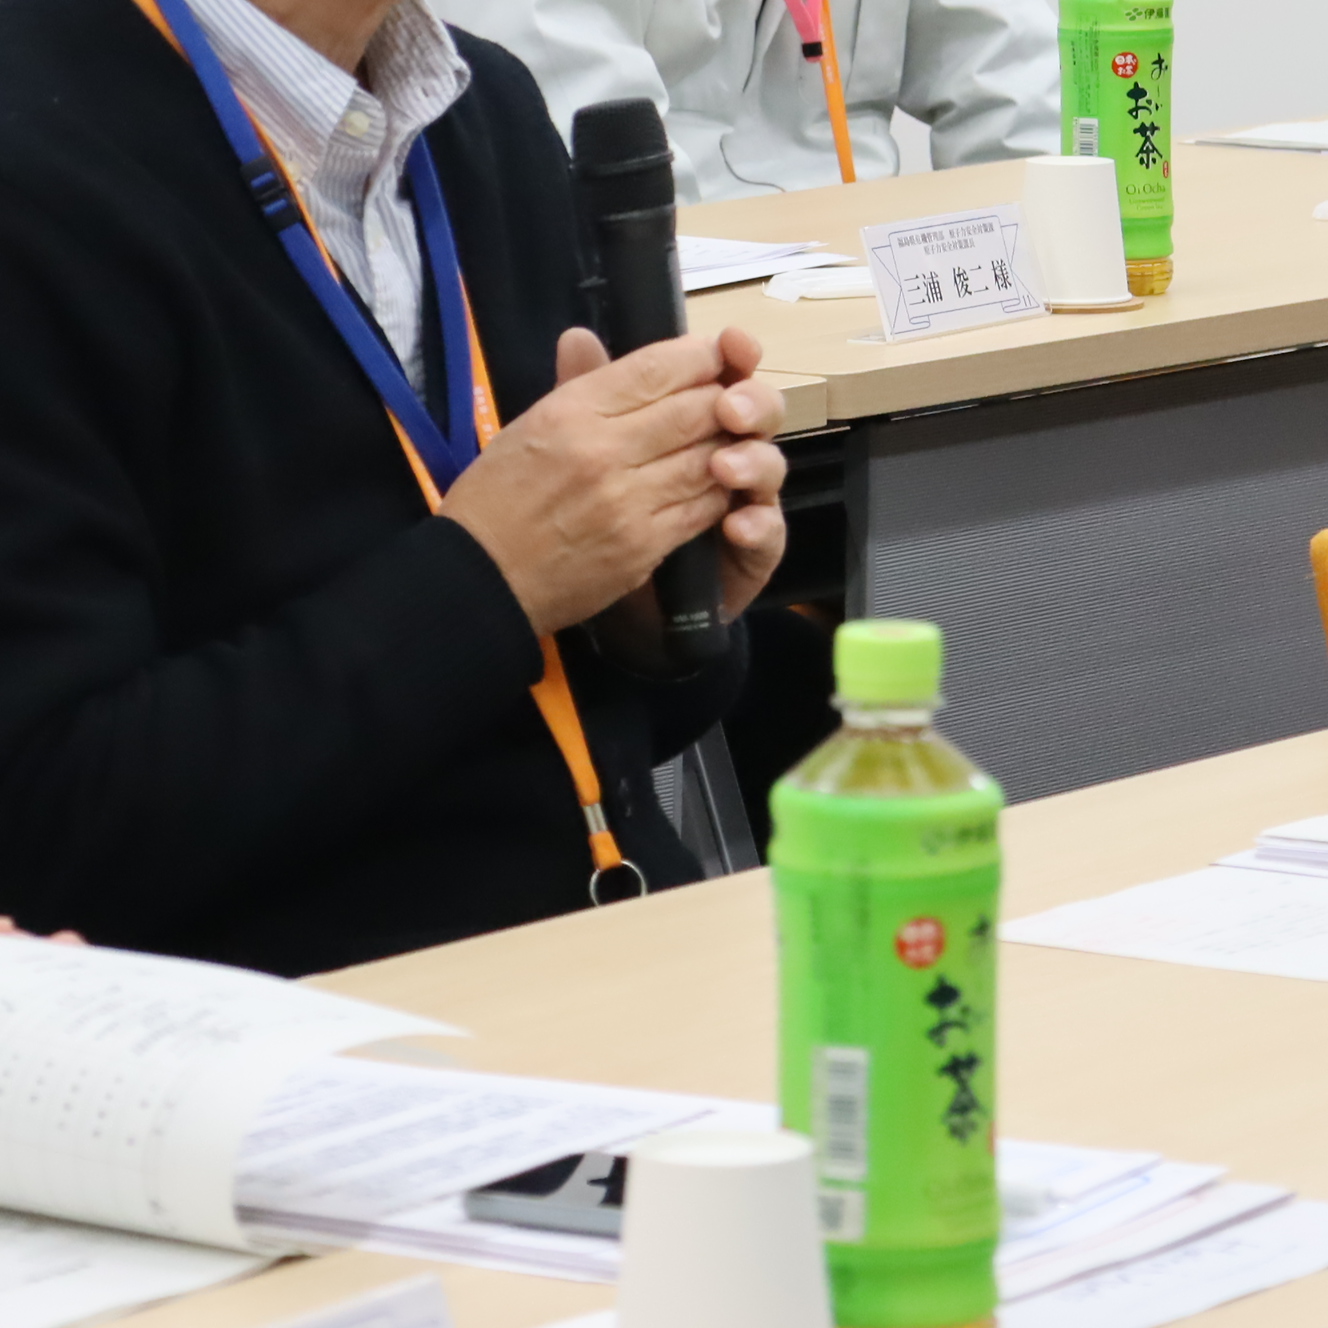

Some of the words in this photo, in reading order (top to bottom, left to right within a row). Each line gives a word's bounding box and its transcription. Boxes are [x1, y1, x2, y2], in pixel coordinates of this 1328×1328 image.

[1126, 81, 1163, 170] お茶
[1125, 183, 1141, 196] Oi
[1143, 182, 1166, 195] Ocha
[903, 271, 943, 306] 三浦
[952, 265, 989, 298] 俊二
[991, 258, 1012, 291] 様
